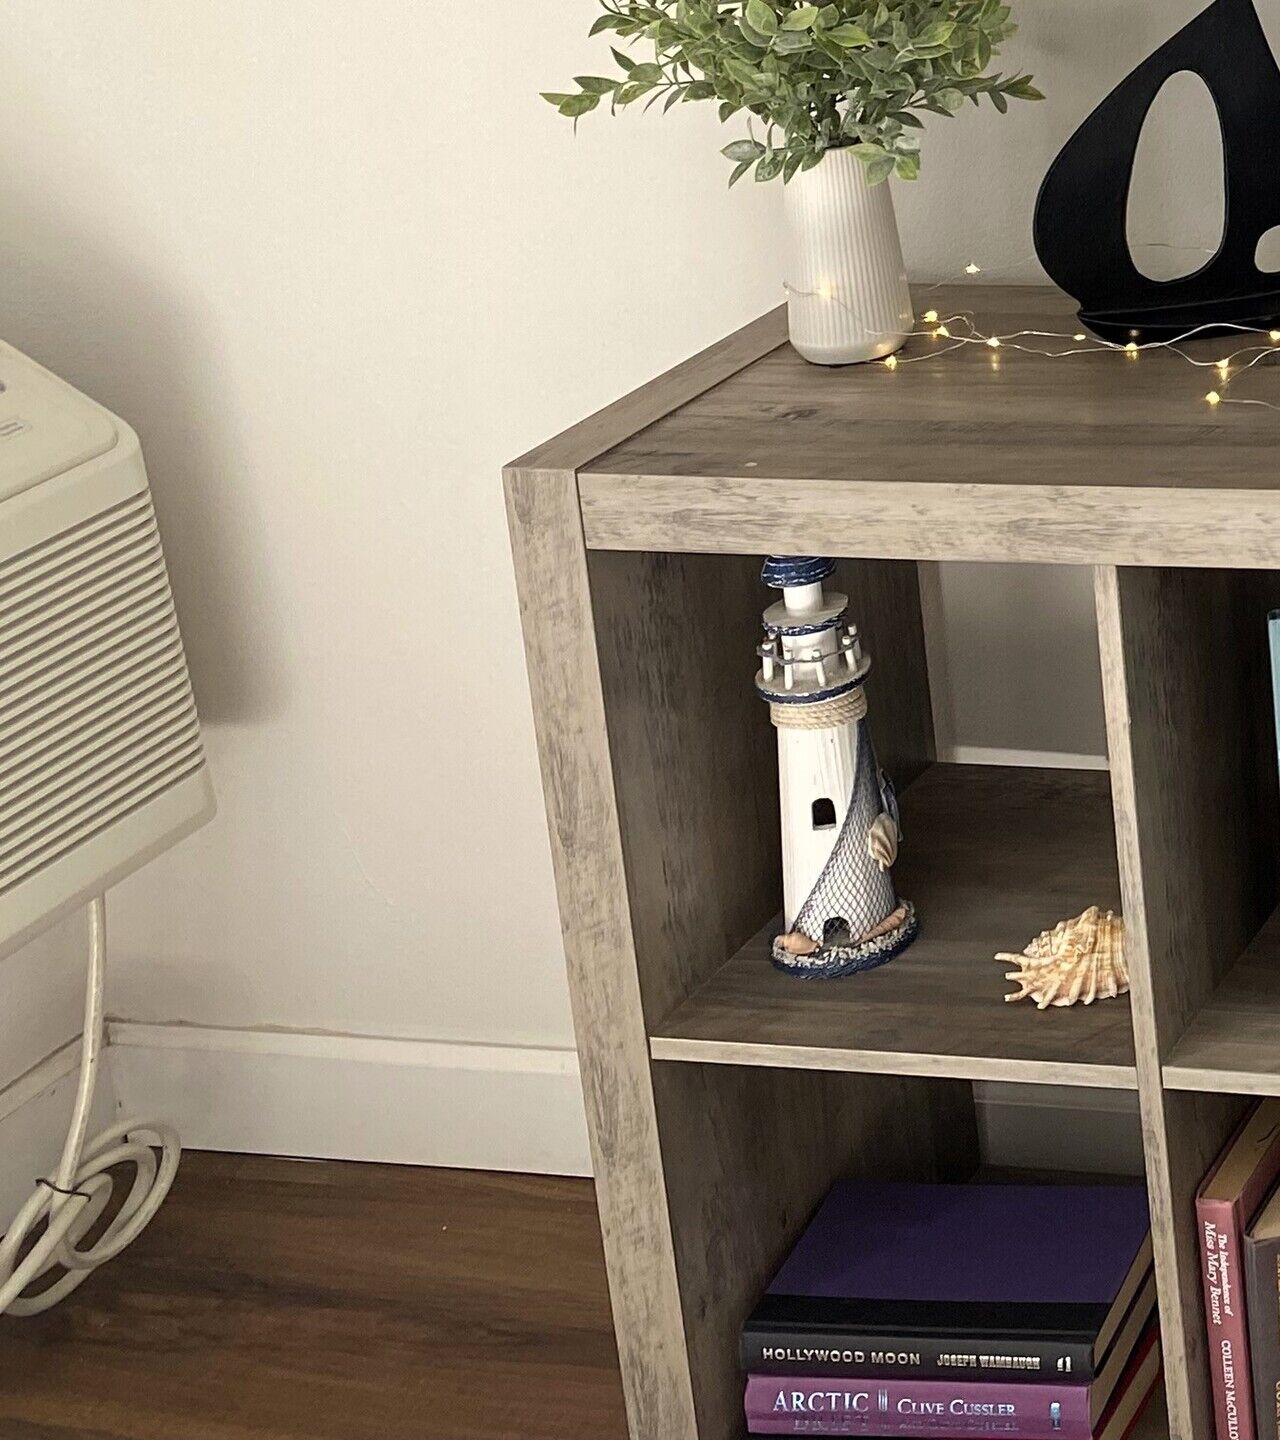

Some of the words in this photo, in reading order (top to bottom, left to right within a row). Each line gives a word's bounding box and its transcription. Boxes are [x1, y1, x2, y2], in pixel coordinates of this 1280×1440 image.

[1204, 1221, 1216, 1250] Miss
[1217, 1233, 1228, 1250] The
[1207, 1251, 1219, 1285] Mary
[1218, 1251, 1232, 1304] Independence
[1209, 1286, 1222, 1325] Bennet
[1223, 1304, 1234, 1317] of
[762, 1347, 865, 1365] HOLLYWOOD
[871, 1351, 920, 1366] MOON
[936, 1353, 977, 1368] JOSEPH
[1221, 1339, 1235, 1388] COLLEEN
[773, 1390, 869, 1413] ARCTIC
[897, 1398, 945, 1416] CLIVE
[949, 1399, 1016, 1417] CUSSLER
[1225, 1390, 1240, 1440] McCULLO
